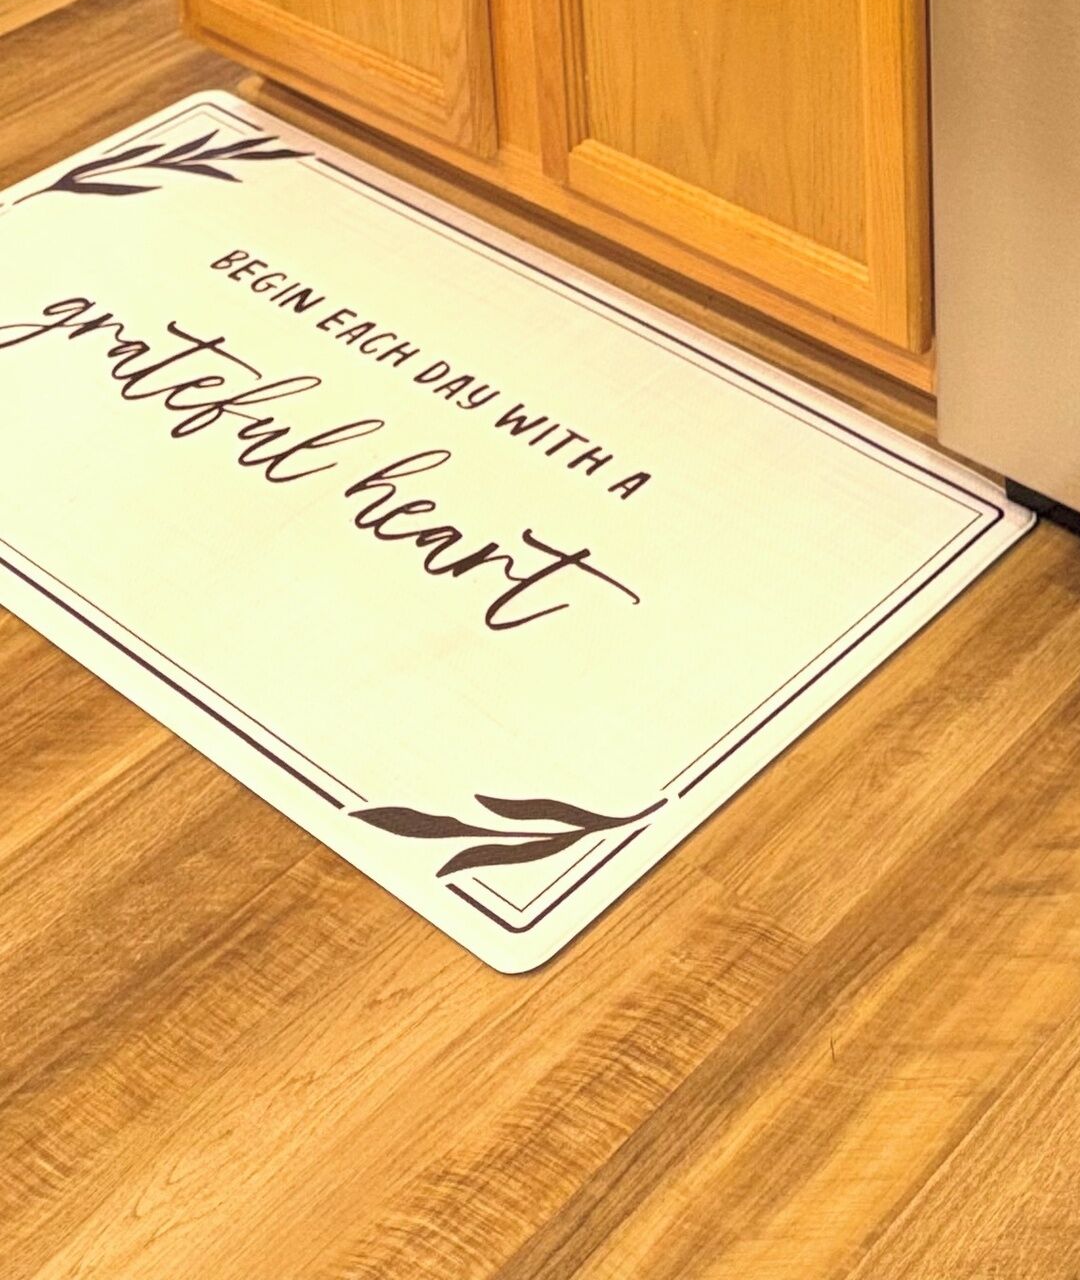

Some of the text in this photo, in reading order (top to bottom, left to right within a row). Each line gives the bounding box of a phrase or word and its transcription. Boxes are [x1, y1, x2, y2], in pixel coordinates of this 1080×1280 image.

[0, 296, 641, 631] grateful heart
[210, 249, 652, 500] BEGIN EACH DAY WITH A
